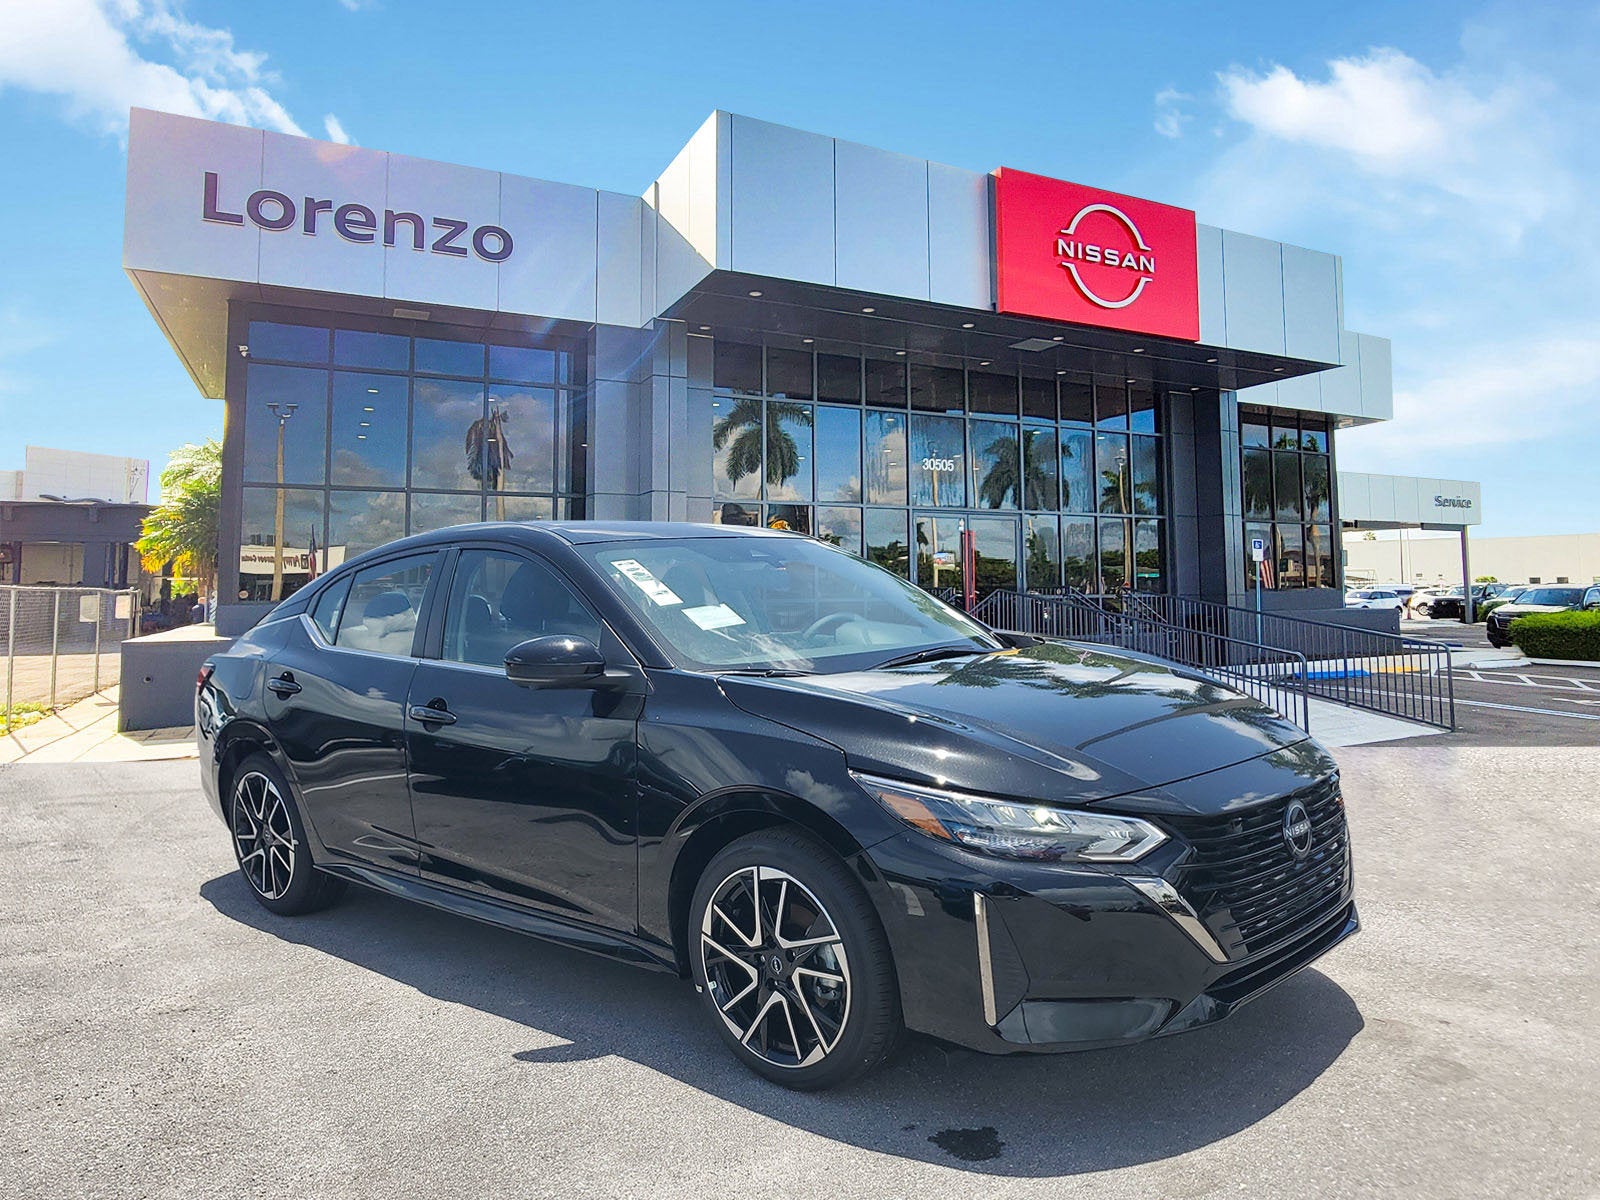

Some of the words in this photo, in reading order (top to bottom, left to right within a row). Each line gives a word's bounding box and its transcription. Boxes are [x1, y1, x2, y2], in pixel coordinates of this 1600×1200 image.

[202, 171, 515, 262] Lorenzo
[1057, 238, 1156, 273] NISSAN
[922, 458, 955, 472] 30505
[1434, 495, 1472, 509] Service
